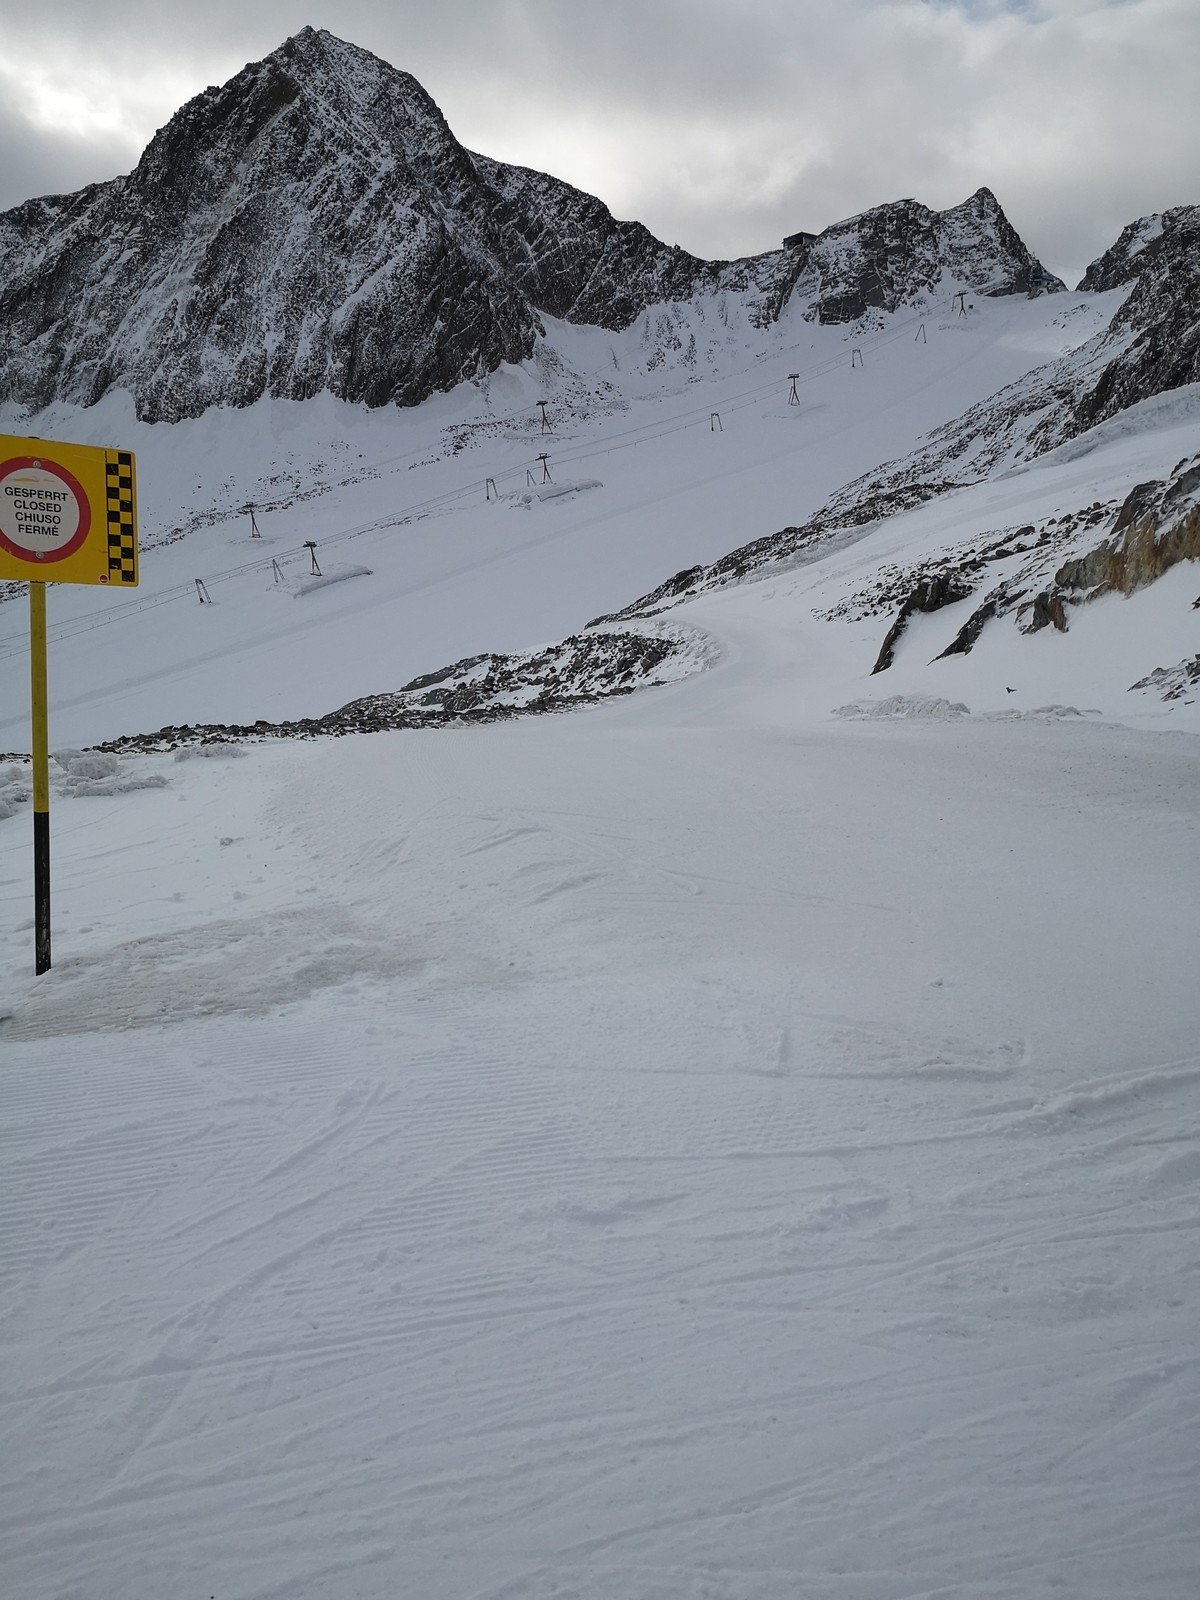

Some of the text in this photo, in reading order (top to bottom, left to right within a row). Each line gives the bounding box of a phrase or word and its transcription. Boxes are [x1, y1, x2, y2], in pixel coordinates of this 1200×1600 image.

[4, 486, 69, 502] GESPERRT
[13, 499, 62, 513] CLOSED
[15, 511, 61, 525] CHIUSO
